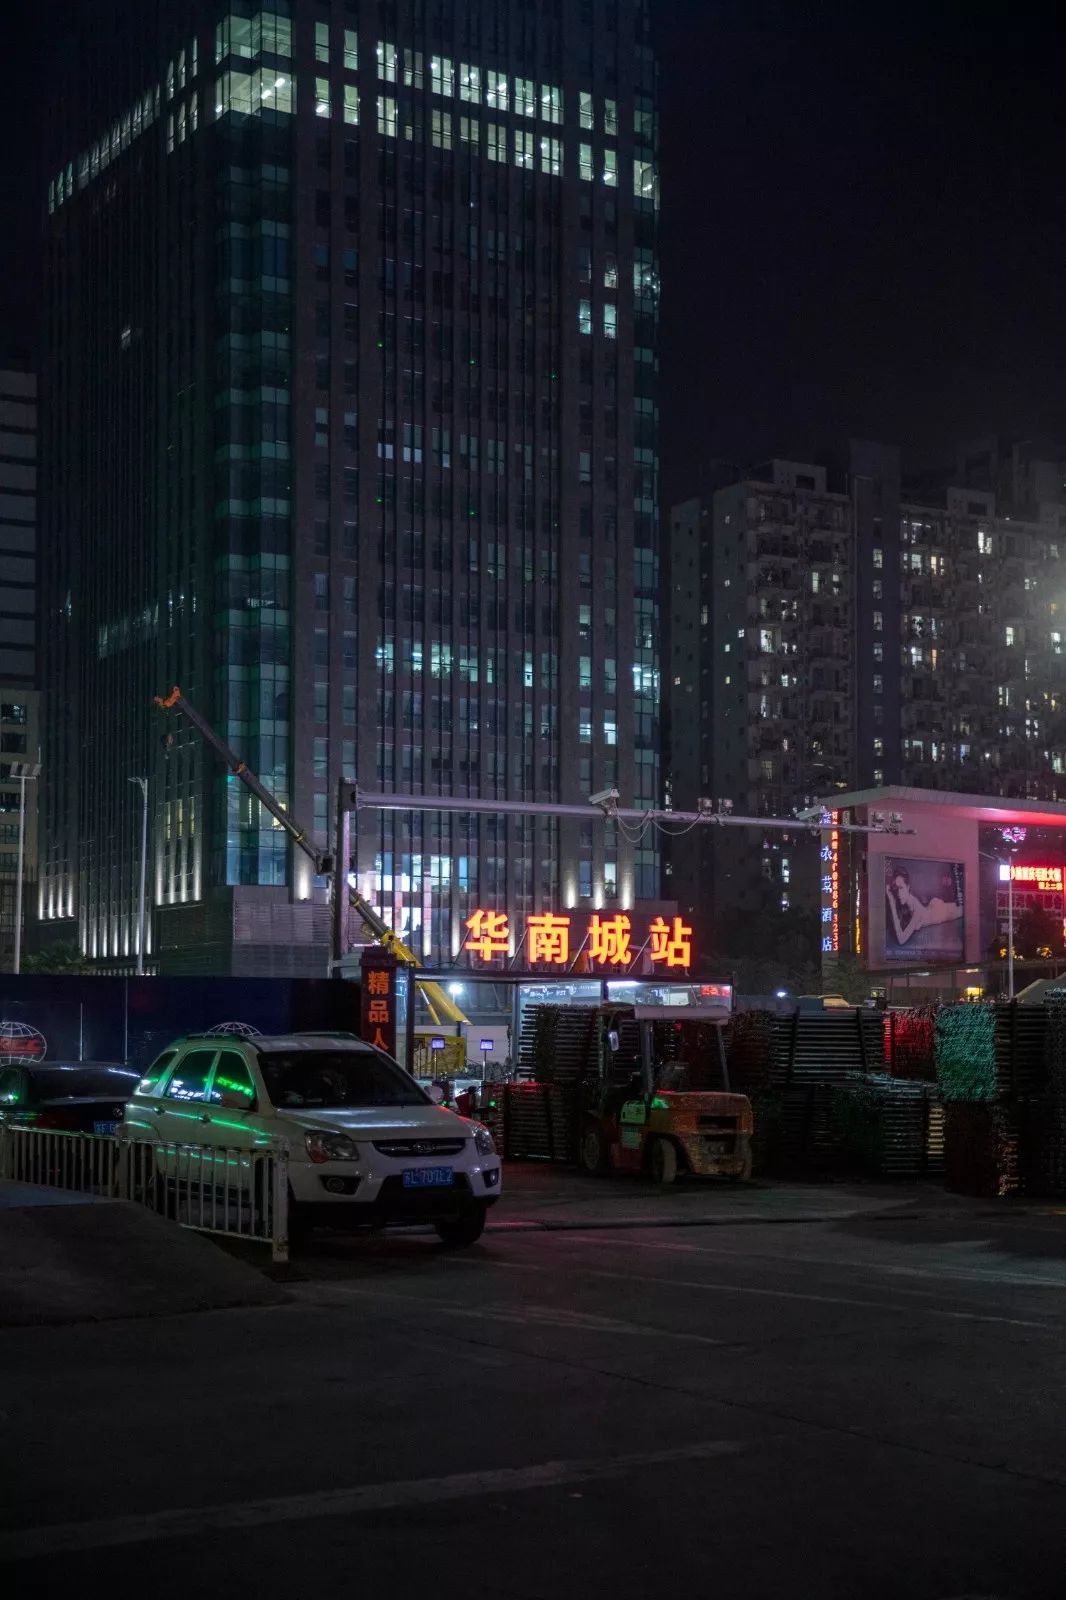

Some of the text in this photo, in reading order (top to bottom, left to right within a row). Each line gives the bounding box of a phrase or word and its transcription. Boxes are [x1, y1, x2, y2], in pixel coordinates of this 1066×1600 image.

[465, 909, 692, 967] 华南城站
[368, 970, 390, 1050] 精品人
